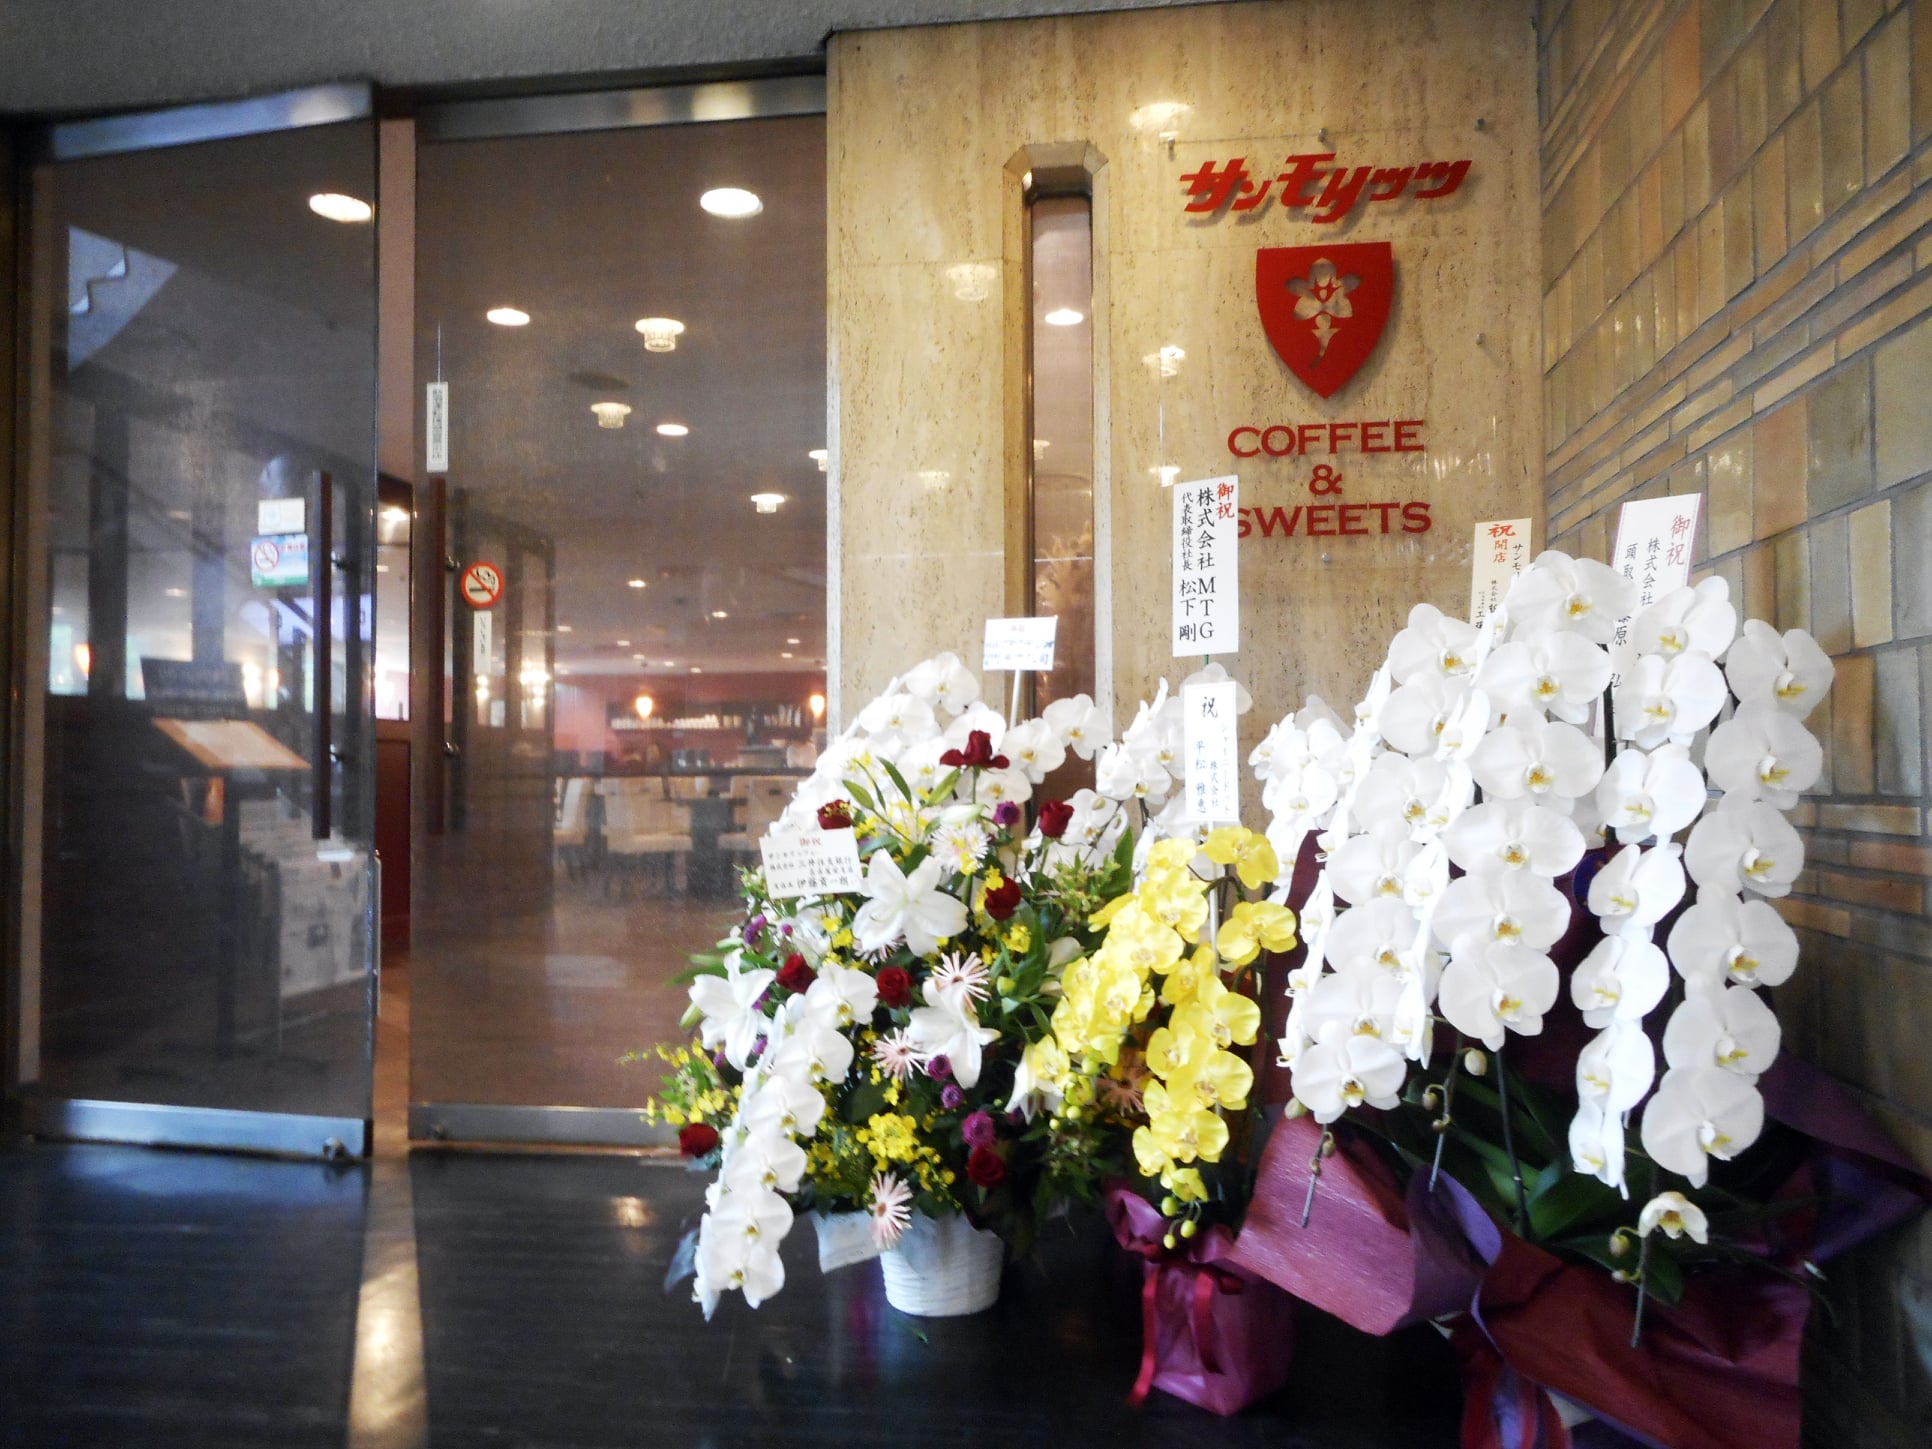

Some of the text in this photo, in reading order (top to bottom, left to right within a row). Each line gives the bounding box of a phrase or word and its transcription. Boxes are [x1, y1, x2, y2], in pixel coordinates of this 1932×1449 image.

[1179, 152, 1472, 224] サンモリッツ
[1227, 420, 1425, 458] COFFEE
[1309, 464, 1343, 496] &
[1216, 482, 1236, 520] 御祝
[1237, 501, 1432, 538] SWEETS
[1494, 538, 1508, 564] 開店
[1666, 514, 1691, 567] 御祝
[1640, 537, 1661, 607] 株式会社
[1202, 696, 1219, 719] 祝
